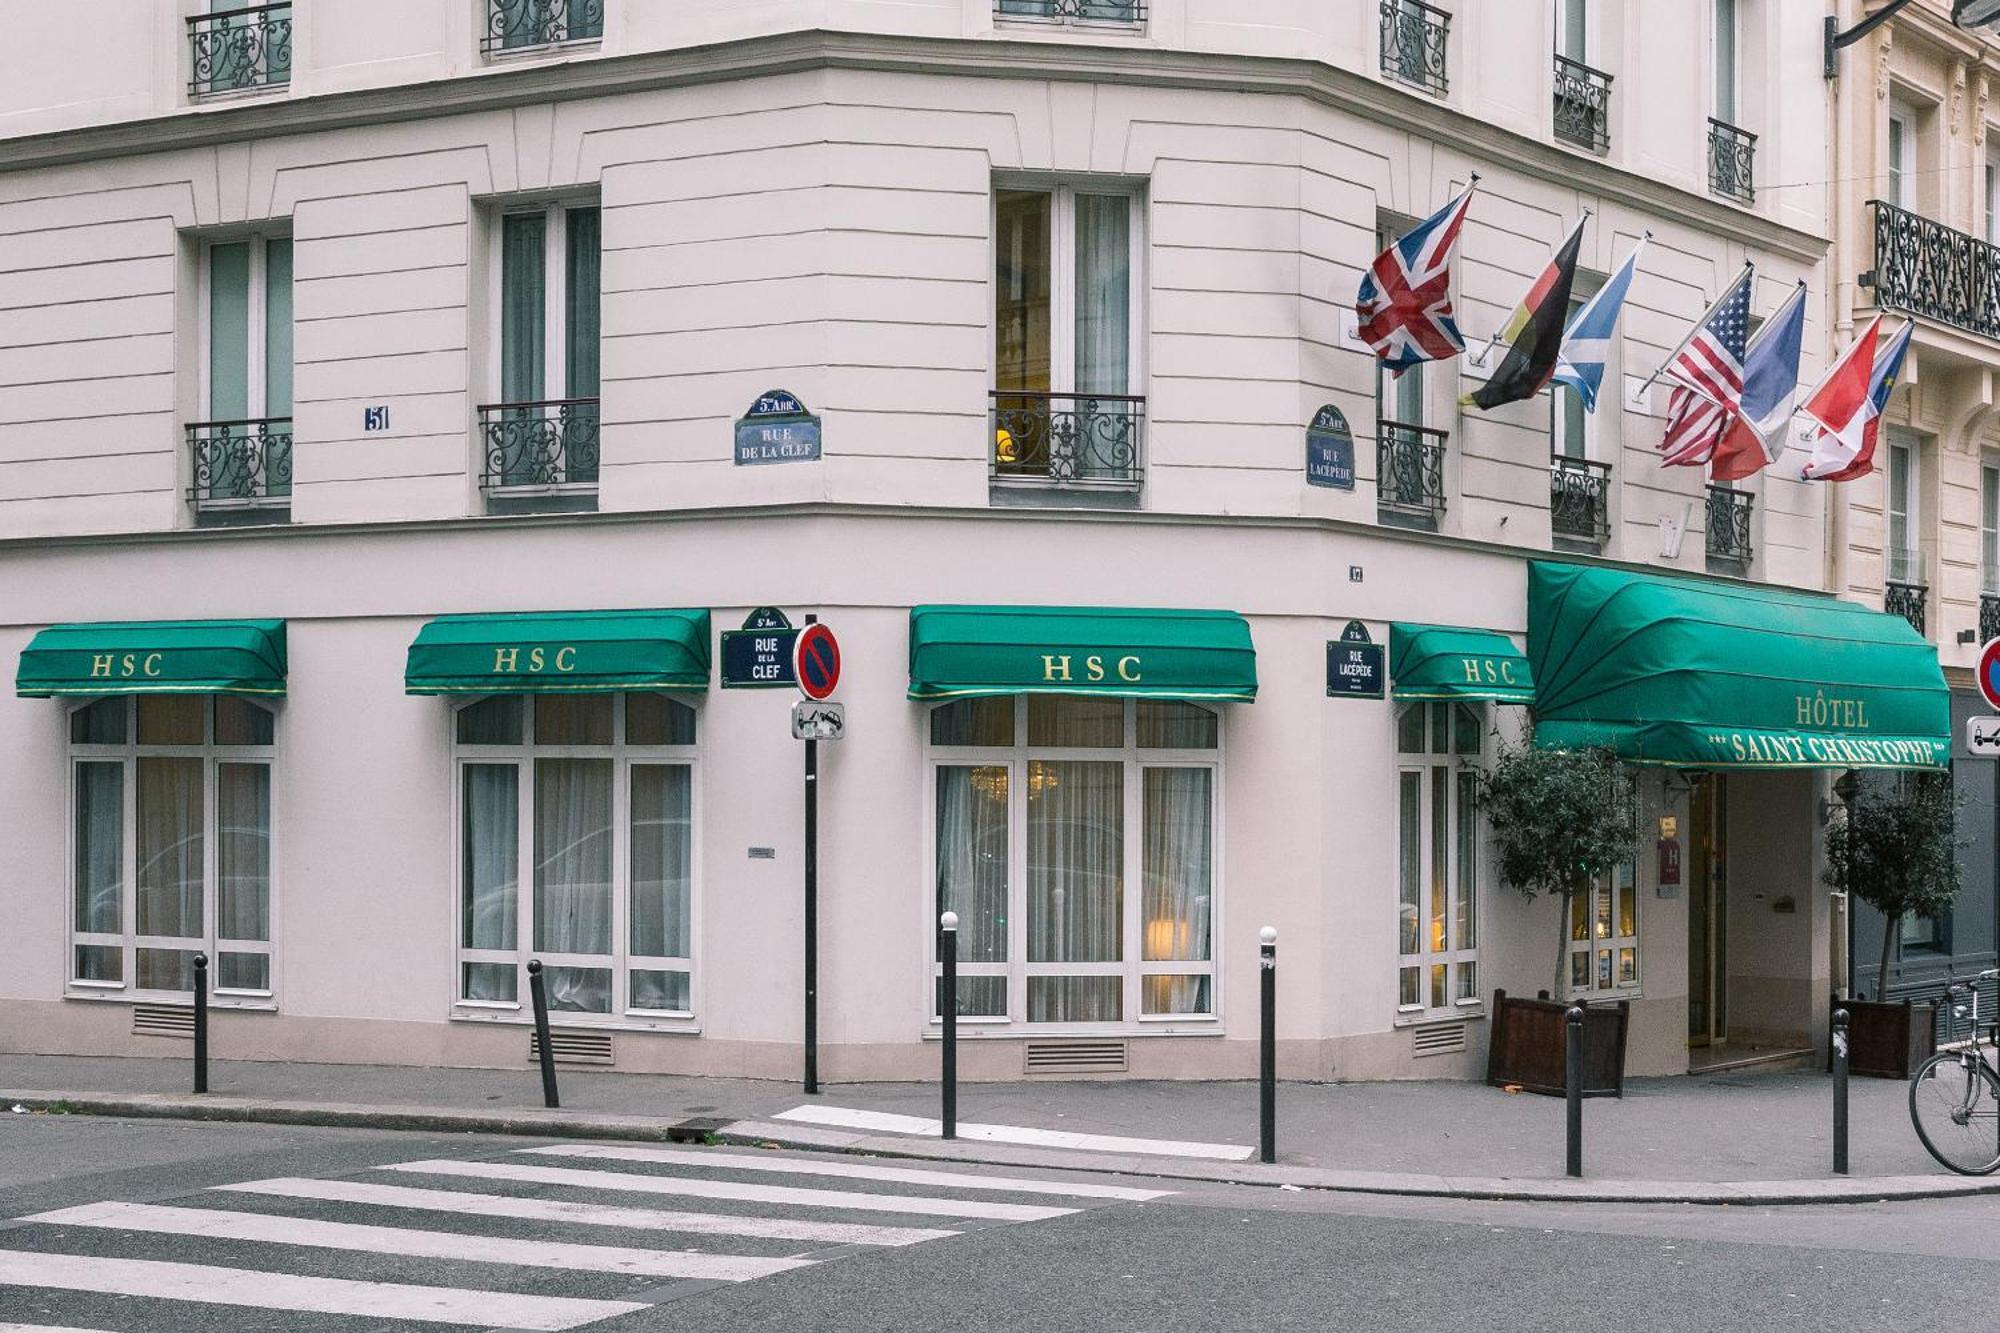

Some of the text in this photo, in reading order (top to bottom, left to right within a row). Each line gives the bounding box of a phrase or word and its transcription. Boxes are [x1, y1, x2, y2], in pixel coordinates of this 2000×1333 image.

[368, 406, 386, 430] 51
[762, 428, 792, 441] RUE
[742, 443, 813, 460] DE LA CLEF
[1323, 449, 1339, 462] RUE
[755, 638, 778, 652] RUE
[758, 654, 775, 663] DE LA
[1349, 650, 1363, 662] RUE
[752, 665, 780, 679] CLEF
[1795, 690, 1869, 728] HÔTEL
[1732, 733, 1935, 765] SAINT CHRISTOPHE
